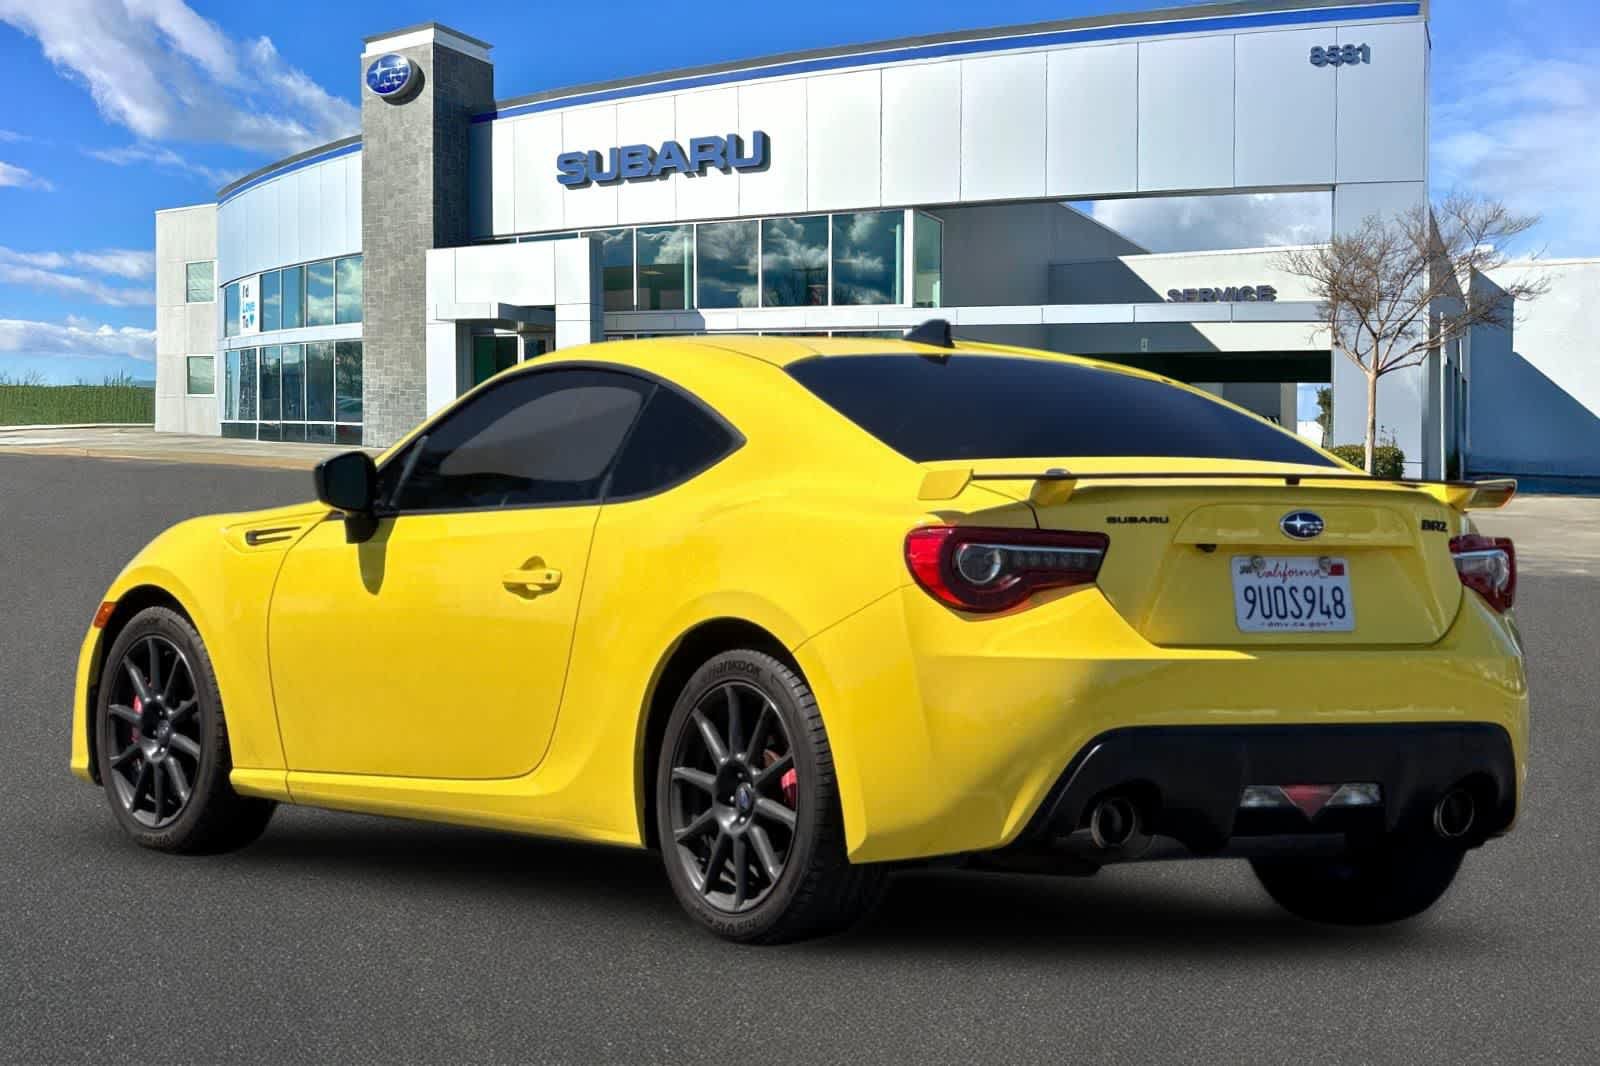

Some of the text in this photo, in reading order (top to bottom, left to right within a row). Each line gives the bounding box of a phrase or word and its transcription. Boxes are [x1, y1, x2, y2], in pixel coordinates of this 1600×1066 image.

[557, 130, 768, 187] SUBARU
[1167, 285, 1276, 302] SERVICE
[1106, 516, 1169, 524] SUBARU
[1421, 519, 1448, 532] BRZ
